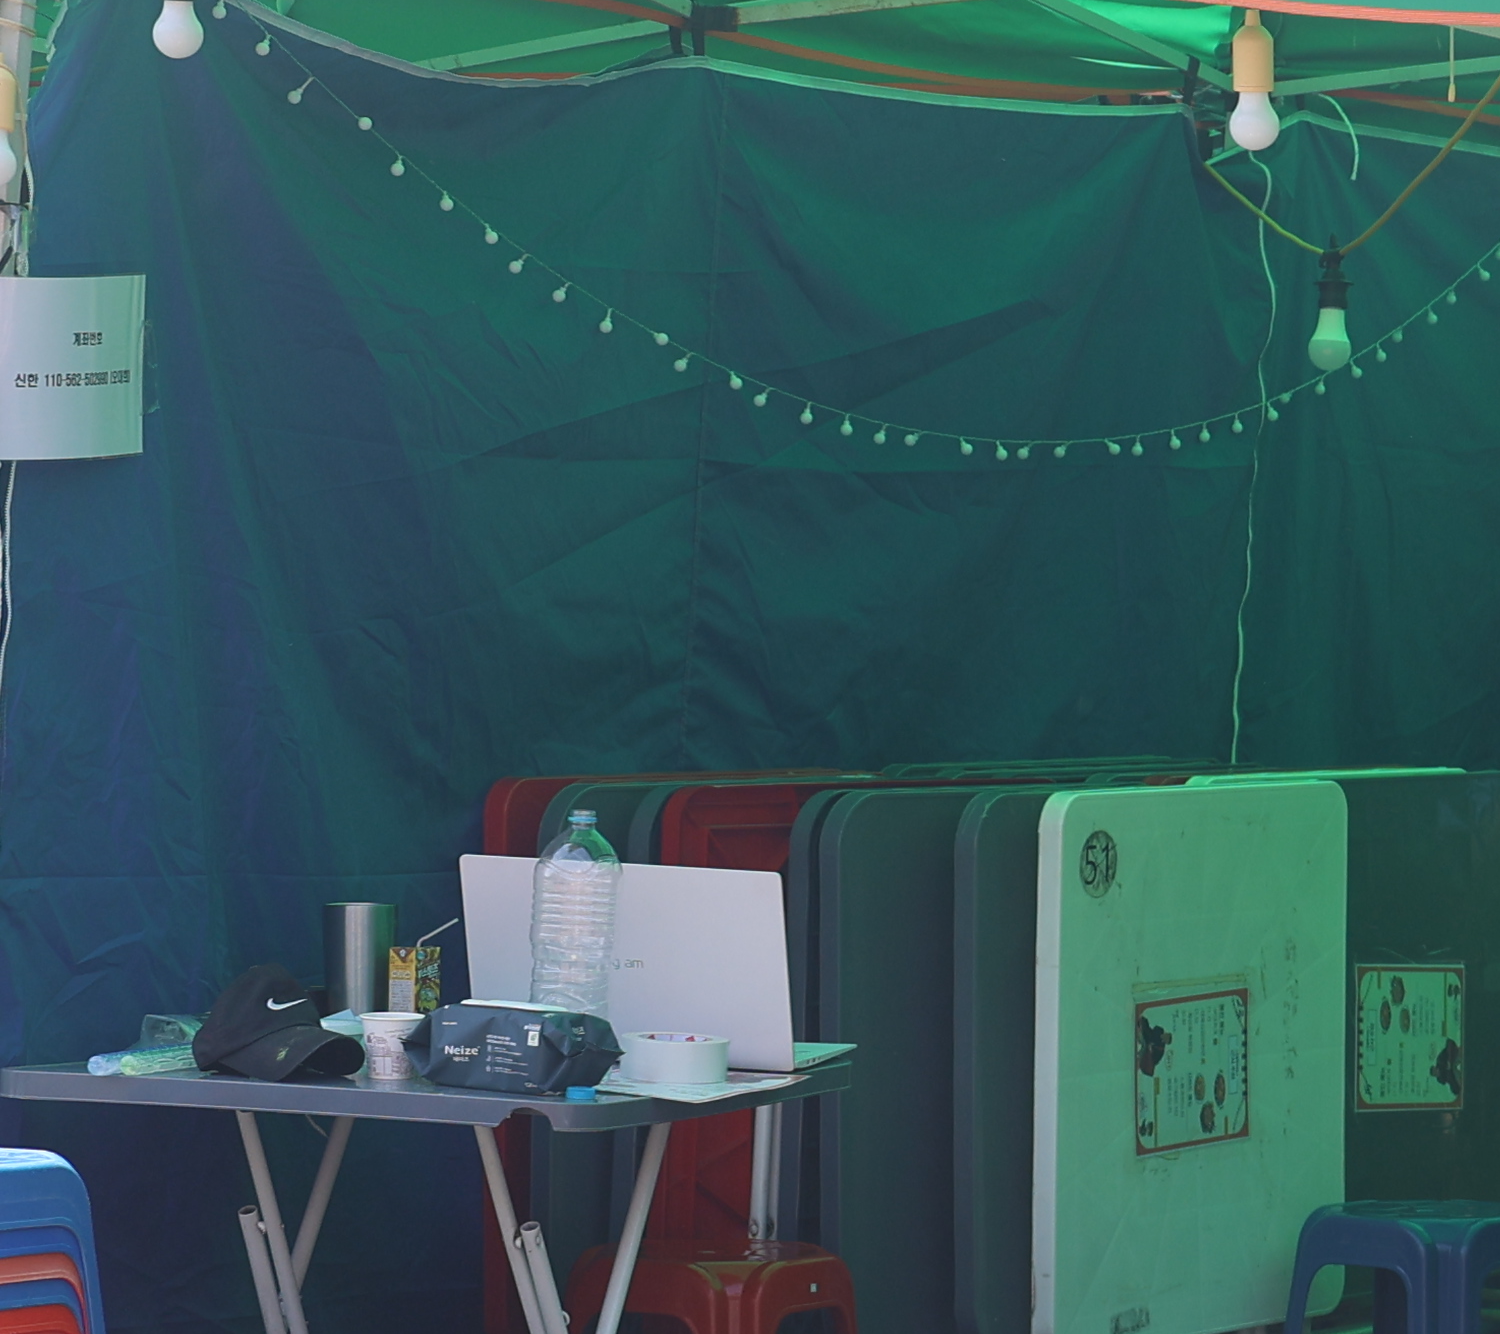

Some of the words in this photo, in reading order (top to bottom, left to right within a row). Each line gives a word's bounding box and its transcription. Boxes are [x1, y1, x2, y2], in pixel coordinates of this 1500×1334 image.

[14, 373, 39, 388] 신한
[1083, 842, 1117, 886] 51
[444, 1044, 479, 1056] Neize
